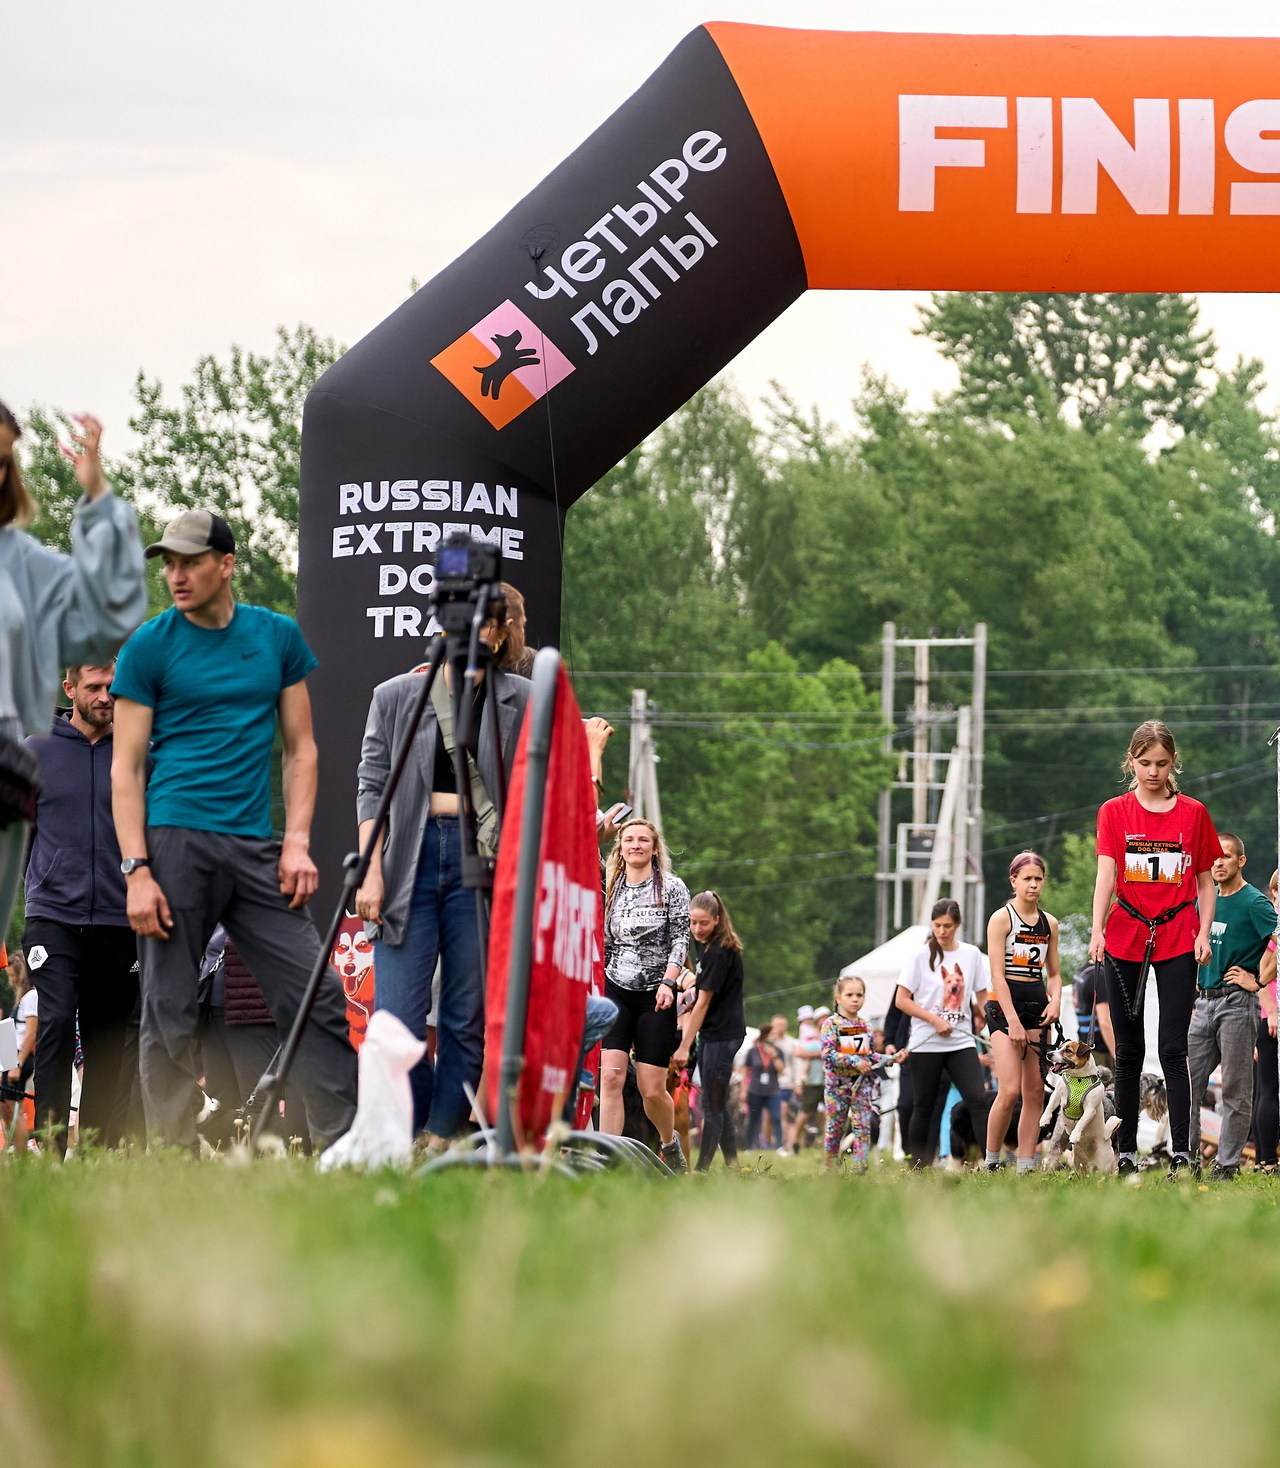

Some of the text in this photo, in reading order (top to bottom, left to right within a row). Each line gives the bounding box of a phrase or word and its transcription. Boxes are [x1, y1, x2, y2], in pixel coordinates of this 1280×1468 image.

[524, 130, 727, 300] четыре
[570, 211, 719, 356] лапы
[339, 479, 518, 518] RUSSIAN
[378, 564, 435, 596] DO
[1148, 856, 1160, 881] 1
[1028, 947, 1041, 965] 2
[854, 1037, 863, 1052] 7
